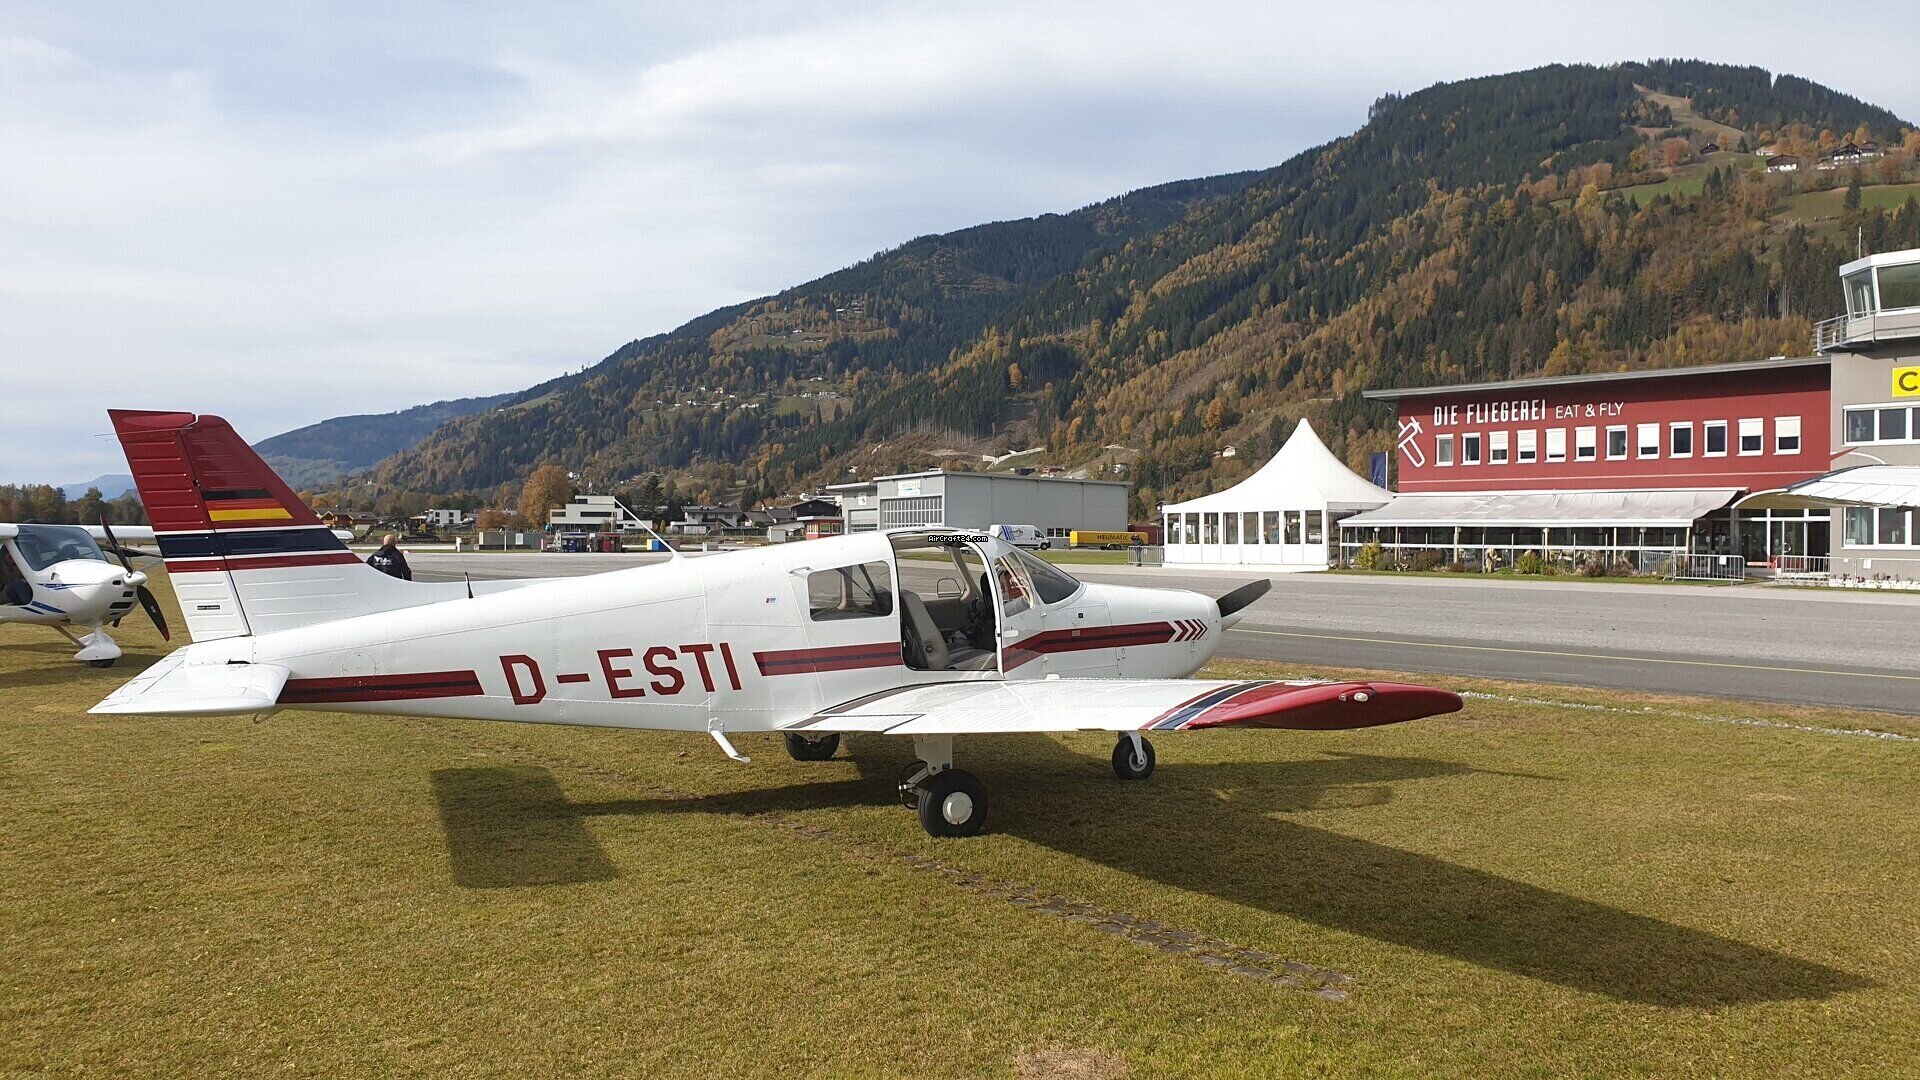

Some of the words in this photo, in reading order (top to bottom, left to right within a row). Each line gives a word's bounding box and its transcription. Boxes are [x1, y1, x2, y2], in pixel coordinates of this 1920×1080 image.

[1434, 405, 1458, 426] DIE
[1466, 399, 1546, 424] FLIEGEREI
[1555, 405, 1580, 419] EAT
[1585, 403, 1596, 417] &
[1599, 402, 1624, 417] FLY
[499, 642, 742, 706] D-ESTI
